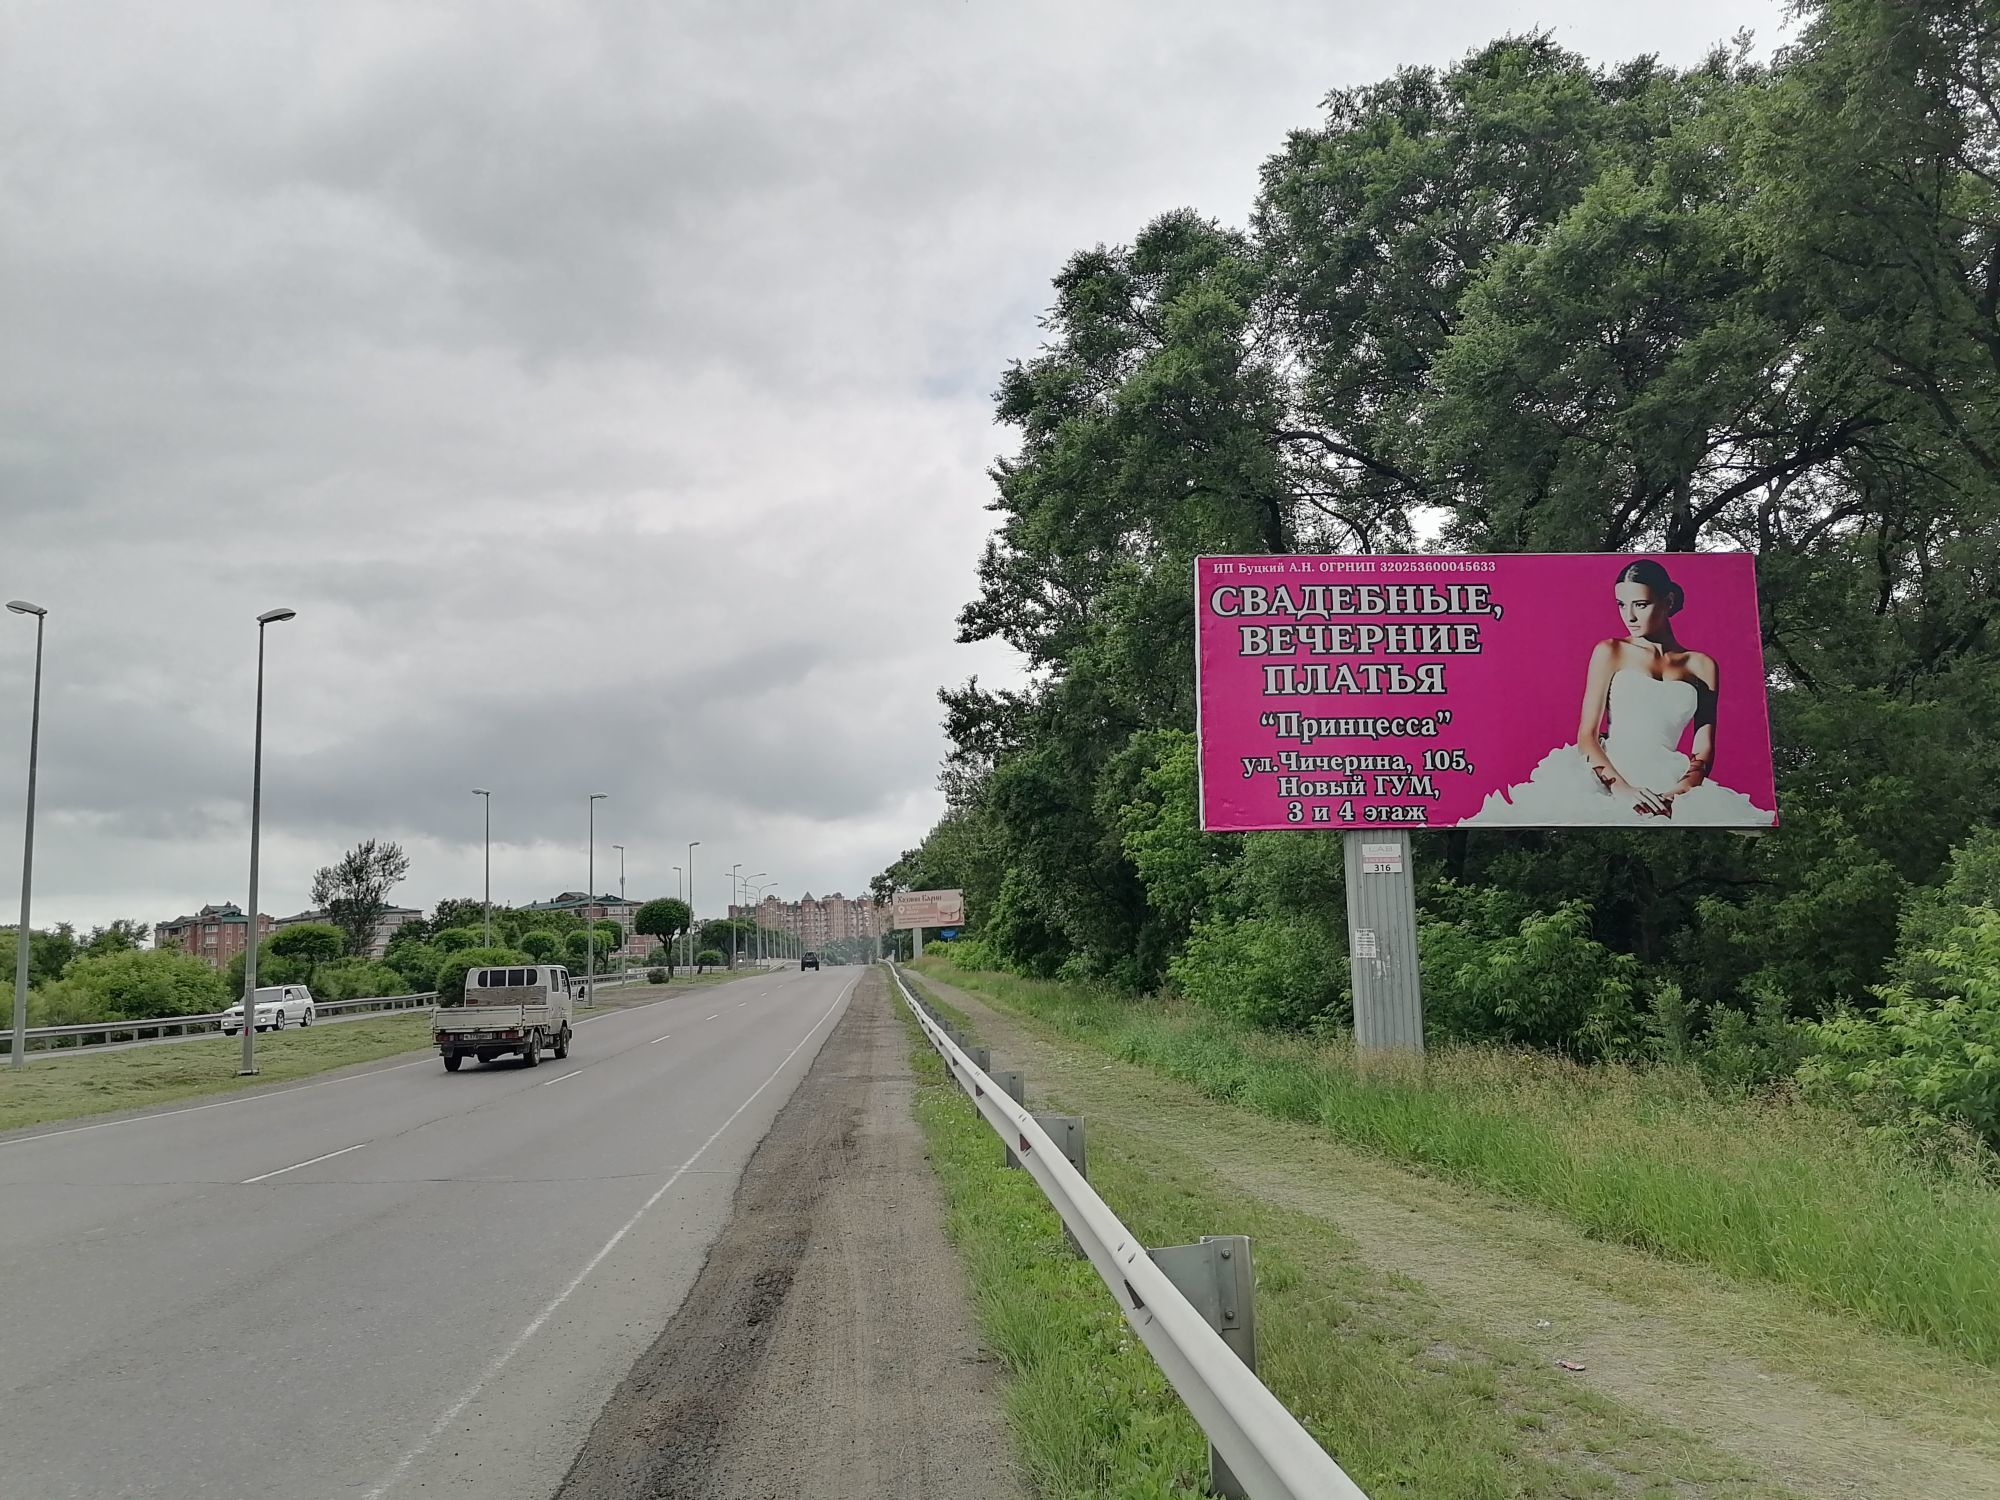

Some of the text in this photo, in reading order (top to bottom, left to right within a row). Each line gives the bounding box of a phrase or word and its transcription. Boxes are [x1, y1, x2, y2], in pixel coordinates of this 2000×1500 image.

[1213, 561, 1496, 576] ИП Буцкий А.Н. ОГРНИП 320253600045633
[1211, 584, 1503, 620] СВАДЕБНЫЕ,
[1239, 623, 1482, 656] ВЕЧЕРНИЕ
[1262, 663, 1448, 696] ПЛАТЬЯ
[1423, 749, 1474, 775] 105,
[1278, 775, 1440, 799] Новый ГУМ,
[1288, 801, 1427, 822] 3 и 4 этаж
[1374, 864, 1391, 872] 316
